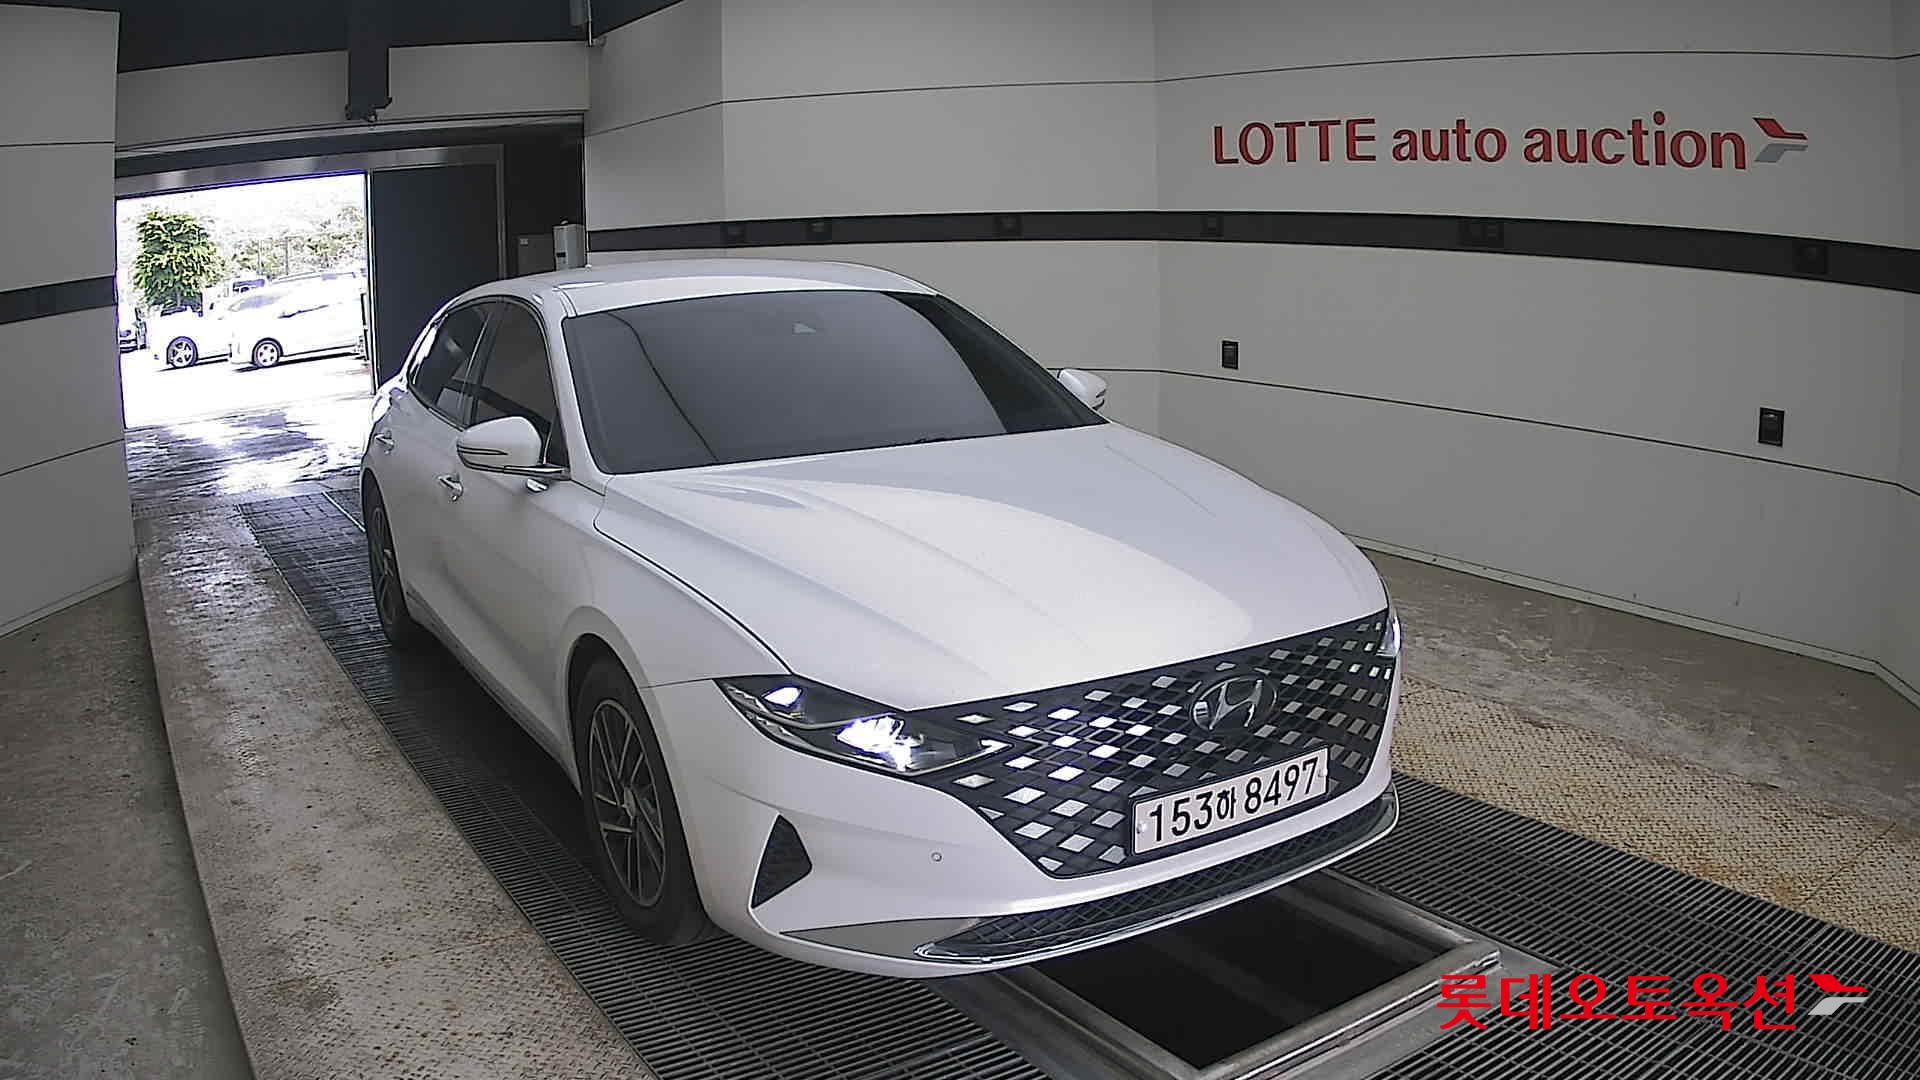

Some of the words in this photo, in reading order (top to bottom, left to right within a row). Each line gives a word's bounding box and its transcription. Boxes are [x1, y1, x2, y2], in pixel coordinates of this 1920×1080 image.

[1212, 117, 1377, 166] LOTTE
[1391, 118, 1508, 163] auto
[1523, 111, 1747, 170] auction
[1150, 787, 1236, 841] 153하
[1244, 757, 1319, 814] 8497
